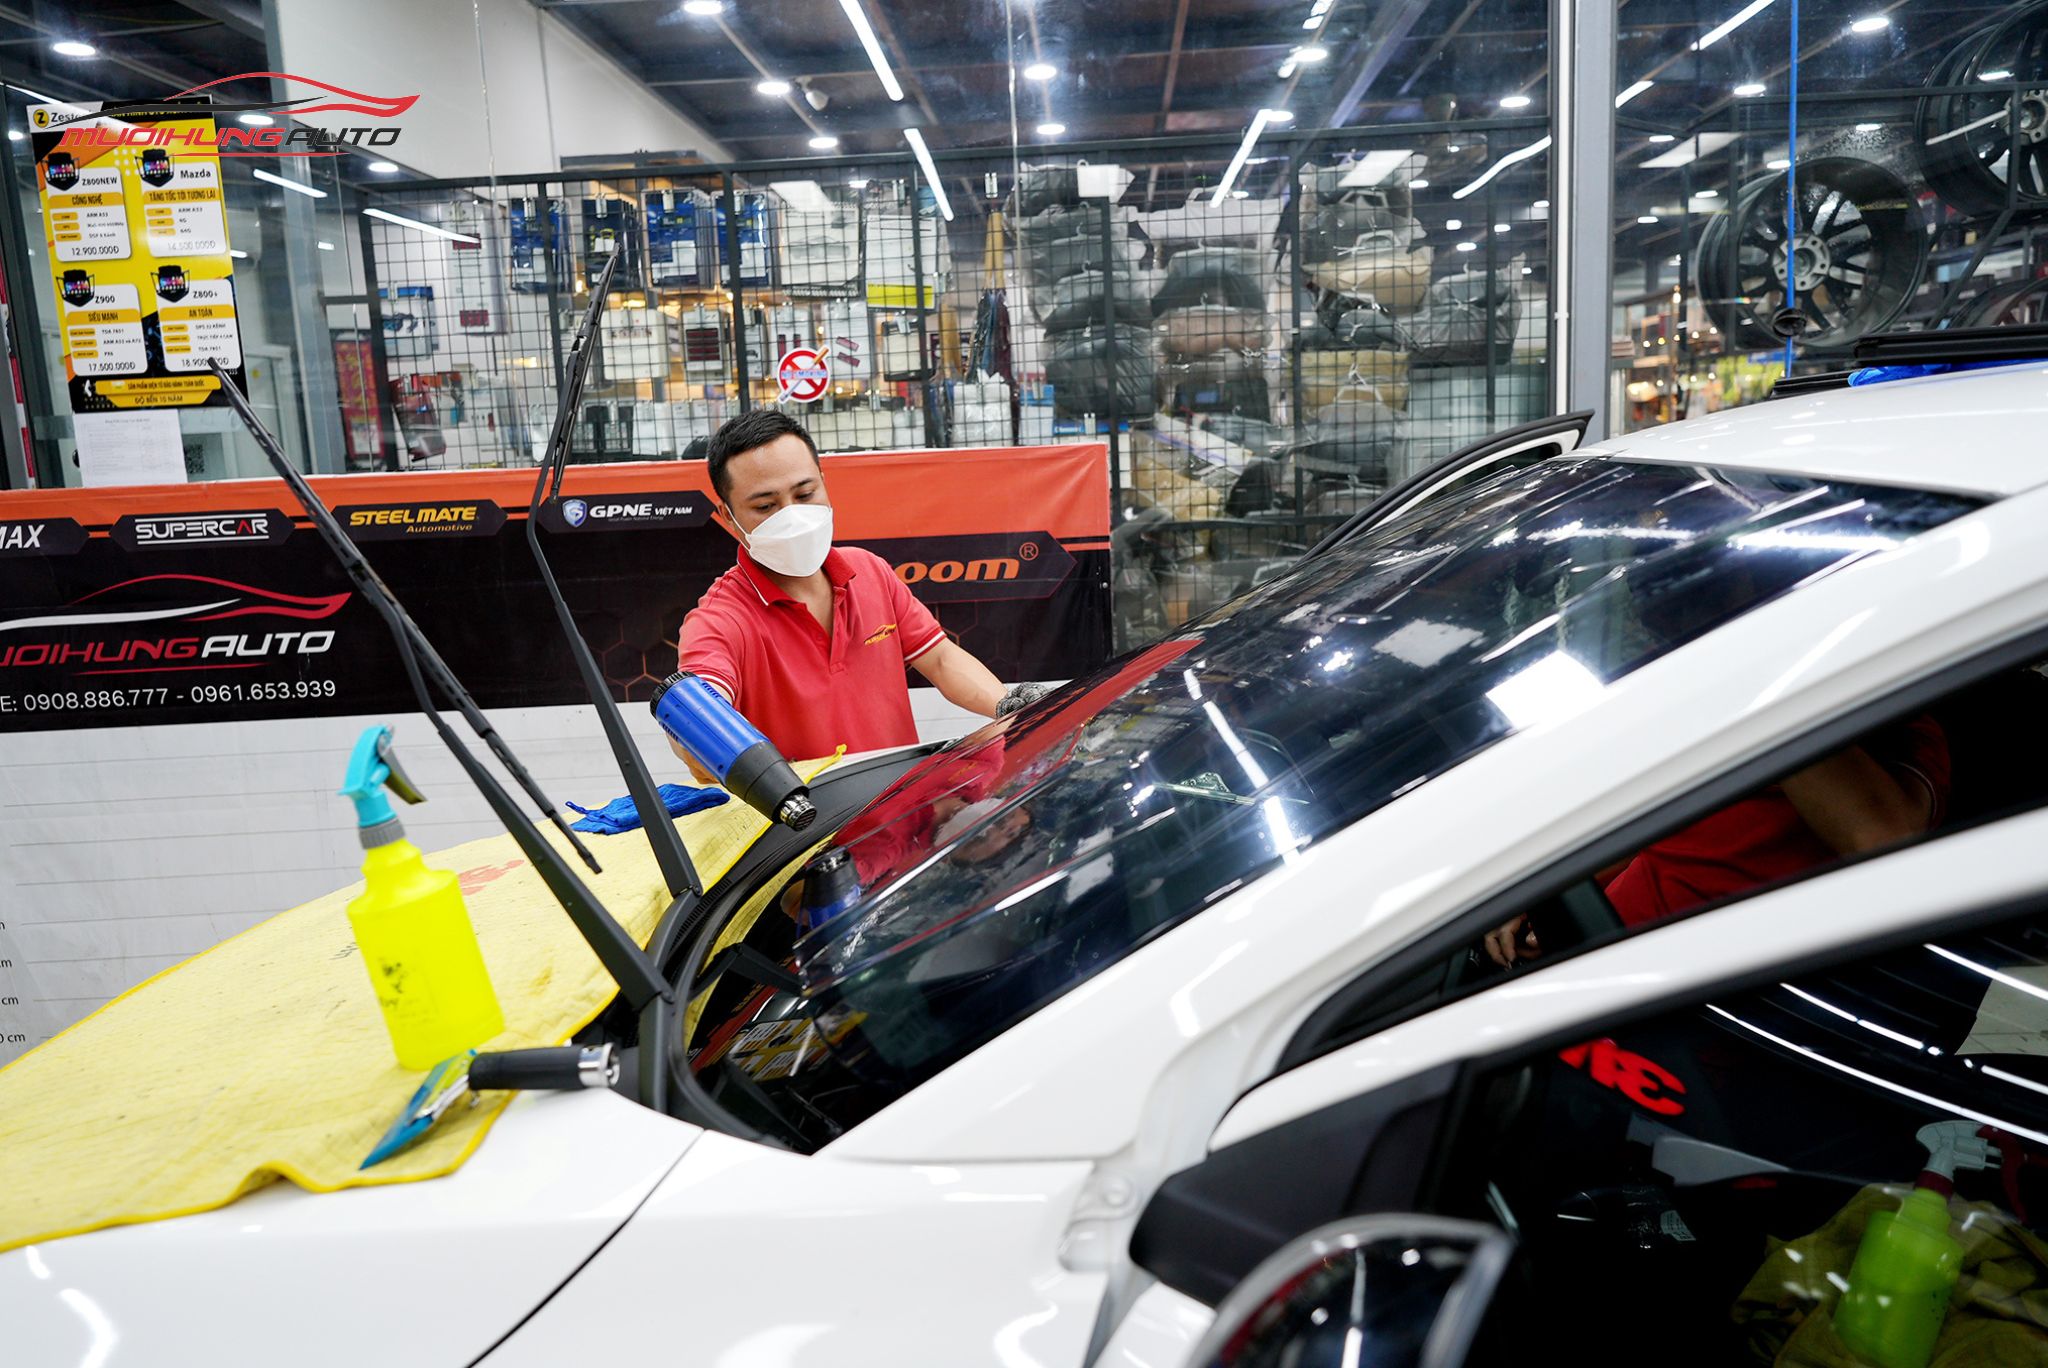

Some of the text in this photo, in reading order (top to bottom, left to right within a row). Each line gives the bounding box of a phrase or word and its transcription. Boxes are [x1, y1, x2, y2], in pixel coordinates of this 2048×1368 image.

[180, 168, 211, 179] Mazda
[81, 177, 118, 186] Z800NEW
[94, 294, 116, 305] Z900
[193, 290, 218, 299] Z800+
[589, 503, 653, 518] GPNE
[655, 507, 673, 516] VIỆT
[135, 518, 269, 540] SUPERCAR
[406, 524, 472, 534] Automotive
[23, 688, 169, 711] 0908.886.777
[190, 680, 336, 703] 0961.653.939
[7, 1033, 26, 1043] cm
